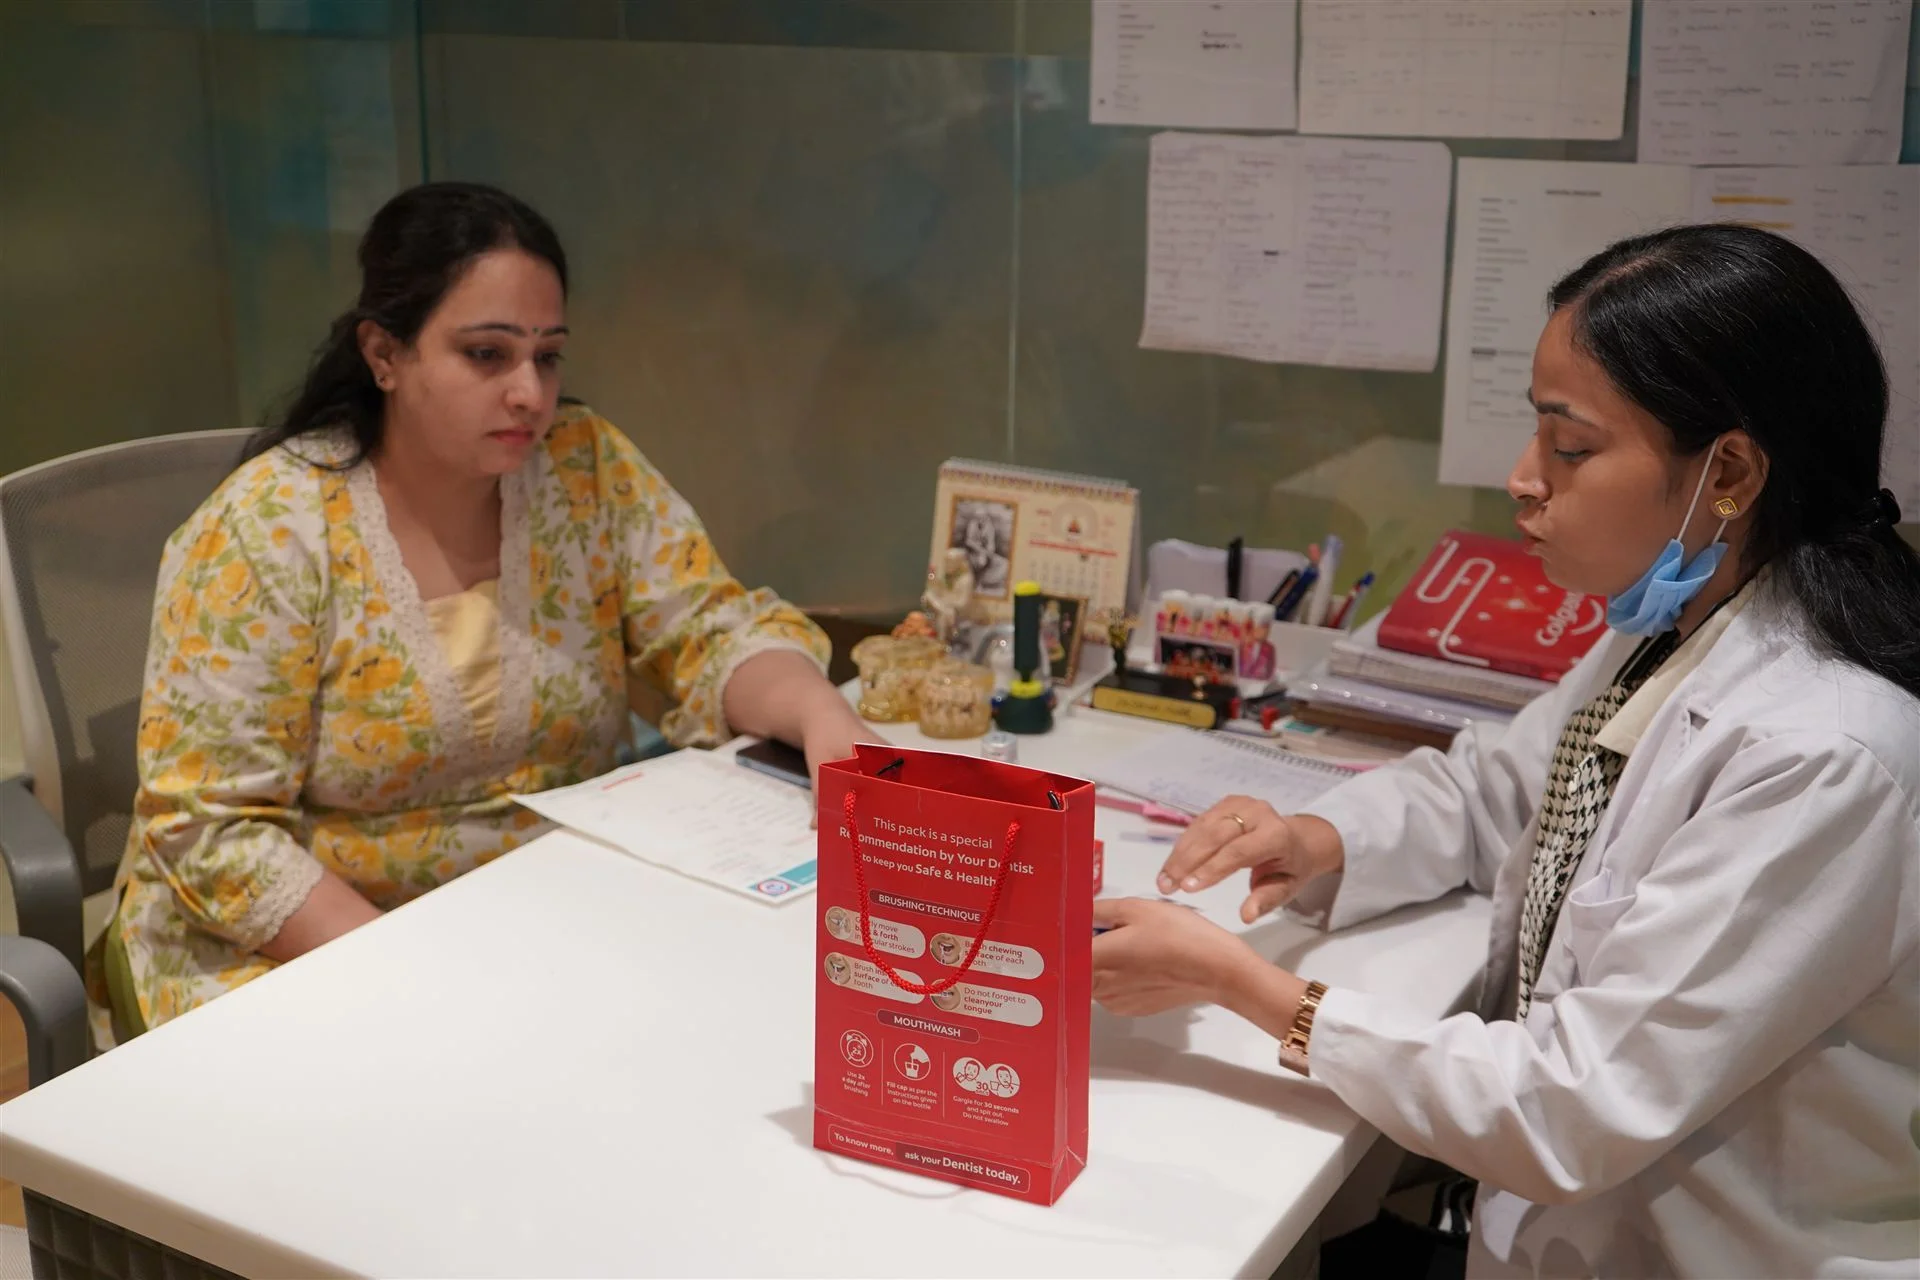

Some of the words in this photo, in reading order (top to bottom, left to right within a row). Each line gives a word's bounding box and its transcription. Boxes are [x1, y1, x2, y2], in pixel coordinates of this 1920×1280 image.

[873, 817, 896, 831] This
[899, 825, 926, 839] pack
[928, 828, 937, 839] is
[940, 833, 947, 842] a
[950, 834, 992, 849] special
[939, 849, 954, 864] by
[957, 853, 985, 867] Your
[862, 853, 872, 863] to
[873, 856, 895, 869] keep
[896, 862, 914, 872] you
[915, 863, 942, 878] Safe
[944, 869, 953, 880] &
[879, 894, 925, 912] BRUSHING
[925, 904, 980, 922] TECHNIQUE
[878, 924, 898, 933] move
[880, 930, 899, 941] forth
[888, 942, 915, 954] strokes
[988, 944, 1023, 958] chewing
[854, 962, 874, 972] Brush
[1005, 957, 1025, 965] each
[853, 970, 880, 983] surface
[853, 979, 873, 989] tooth
[964, 987, 976, 995] Do
[977, 990, 990, 998] not
[992, 991, 1016, 1003] forget
[964, 1004, 993, 1015] tongue
[893, 1015, 961, 1038] MOUTHWASH
[844, 1083, 869, 1097] brushing
[976, 1081, 989, 1091] 30
[966, 1105, 979, 1113] and
[974, 1098, 983, 1106] for
[984, 1101, 993, 1109] 30
[993, 1102, 1019, 1114] seconds
[972, 1113, 983, 1121] not
[834, 1132, 844, 1142] To
[845, 1135, 868, 1148] know
[869, 1143, 894, 1156] more,
[904, 1152, 920, 1162] ask
[920, 1155, 941, 1167] your
[942, 1157, 983, 1175] Dentist
[985, 1166, 1021, 1185] today.
